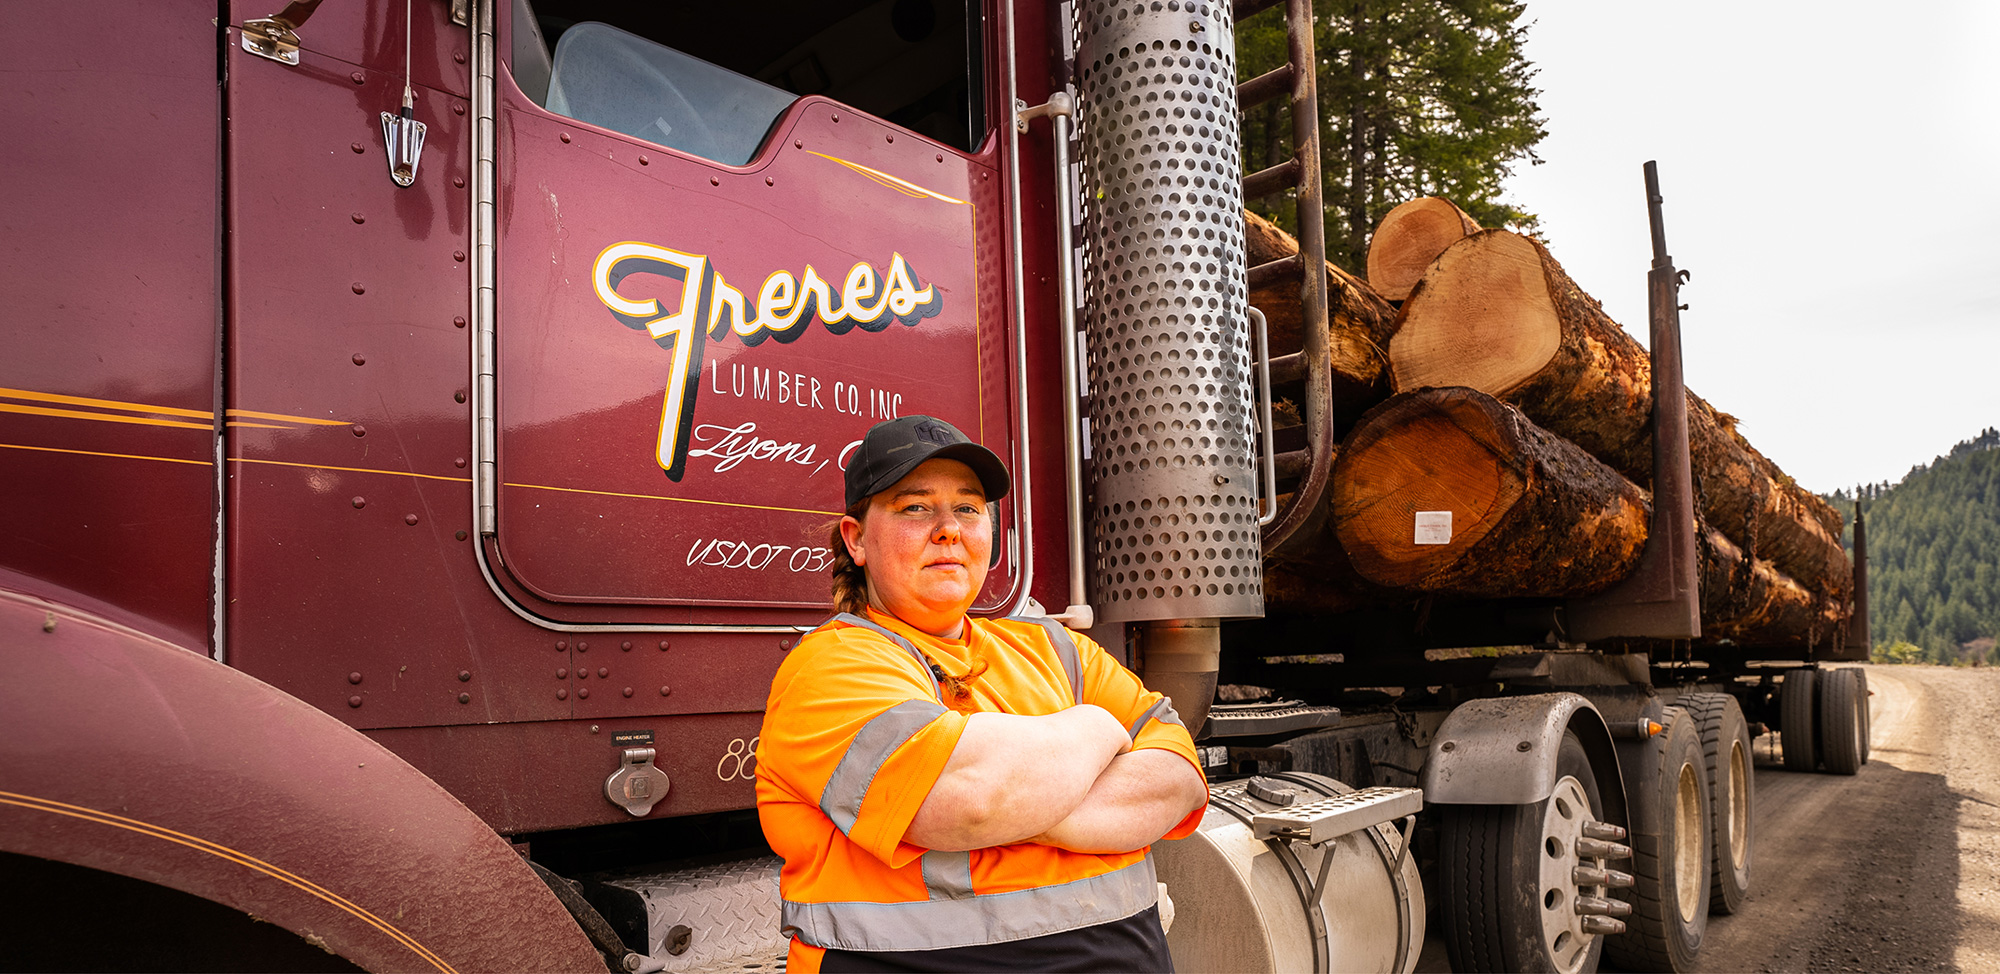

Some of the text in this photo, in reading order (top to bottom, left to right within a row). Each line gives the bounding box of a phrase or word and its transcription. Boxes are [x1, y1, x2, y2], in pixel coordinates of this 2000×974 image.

[592, 241, 941, 480] Freres
[711, 359, 825, 410] LUMBER
[835, 381, 863, 417] CO.
[688, 422, 830, 479] Lyons,
[686, 538, 792, 573] USDOT
[717, 736, 760, 782] 88
